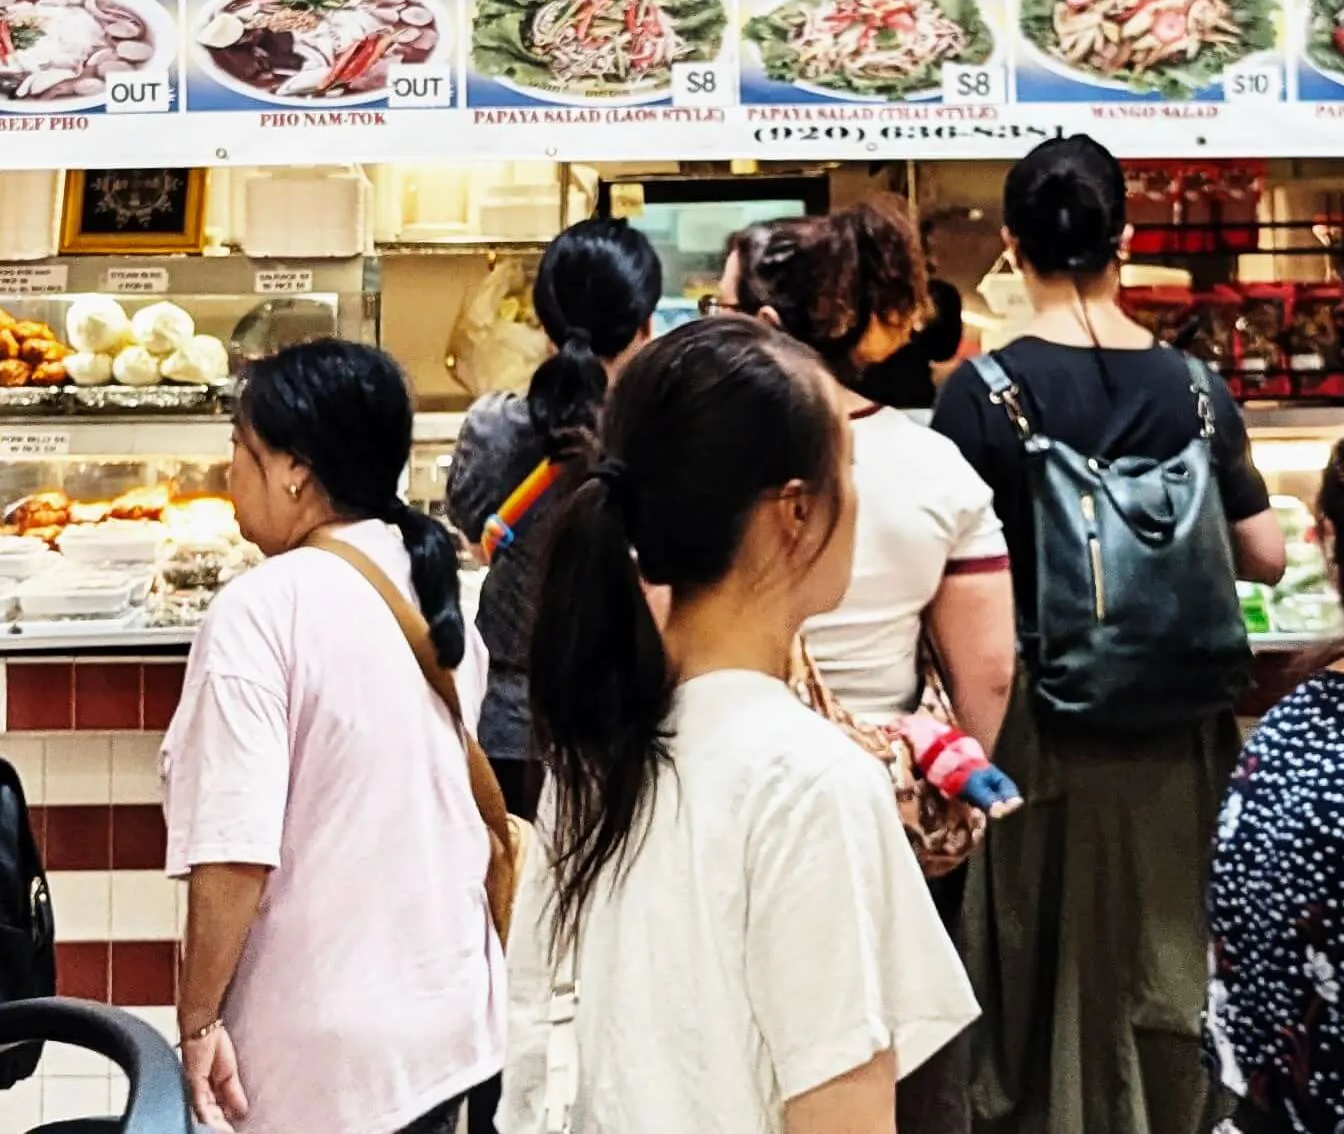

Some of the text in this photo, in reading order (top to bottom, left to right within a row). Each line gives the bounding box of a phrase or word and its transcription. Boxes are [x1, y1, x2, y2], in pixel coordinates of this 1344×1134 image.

[111, 82, 162, 104] OUT
[393, 76, 444, 98] OUT
[686, 71, 717, 94] $8
[957, 73, 991, 96] $8
[1232, 73, 1269, 96] $10
[50, 116, 90, 131] PHO
[260, 112, 386, 127] PHO NAM-TOK
[473, 107, 725, 125] PAPAYA SALAD (LAOS STYLE)
[747, 106, 999, 122] PAPAYA SALAD (THAI STYLE)
